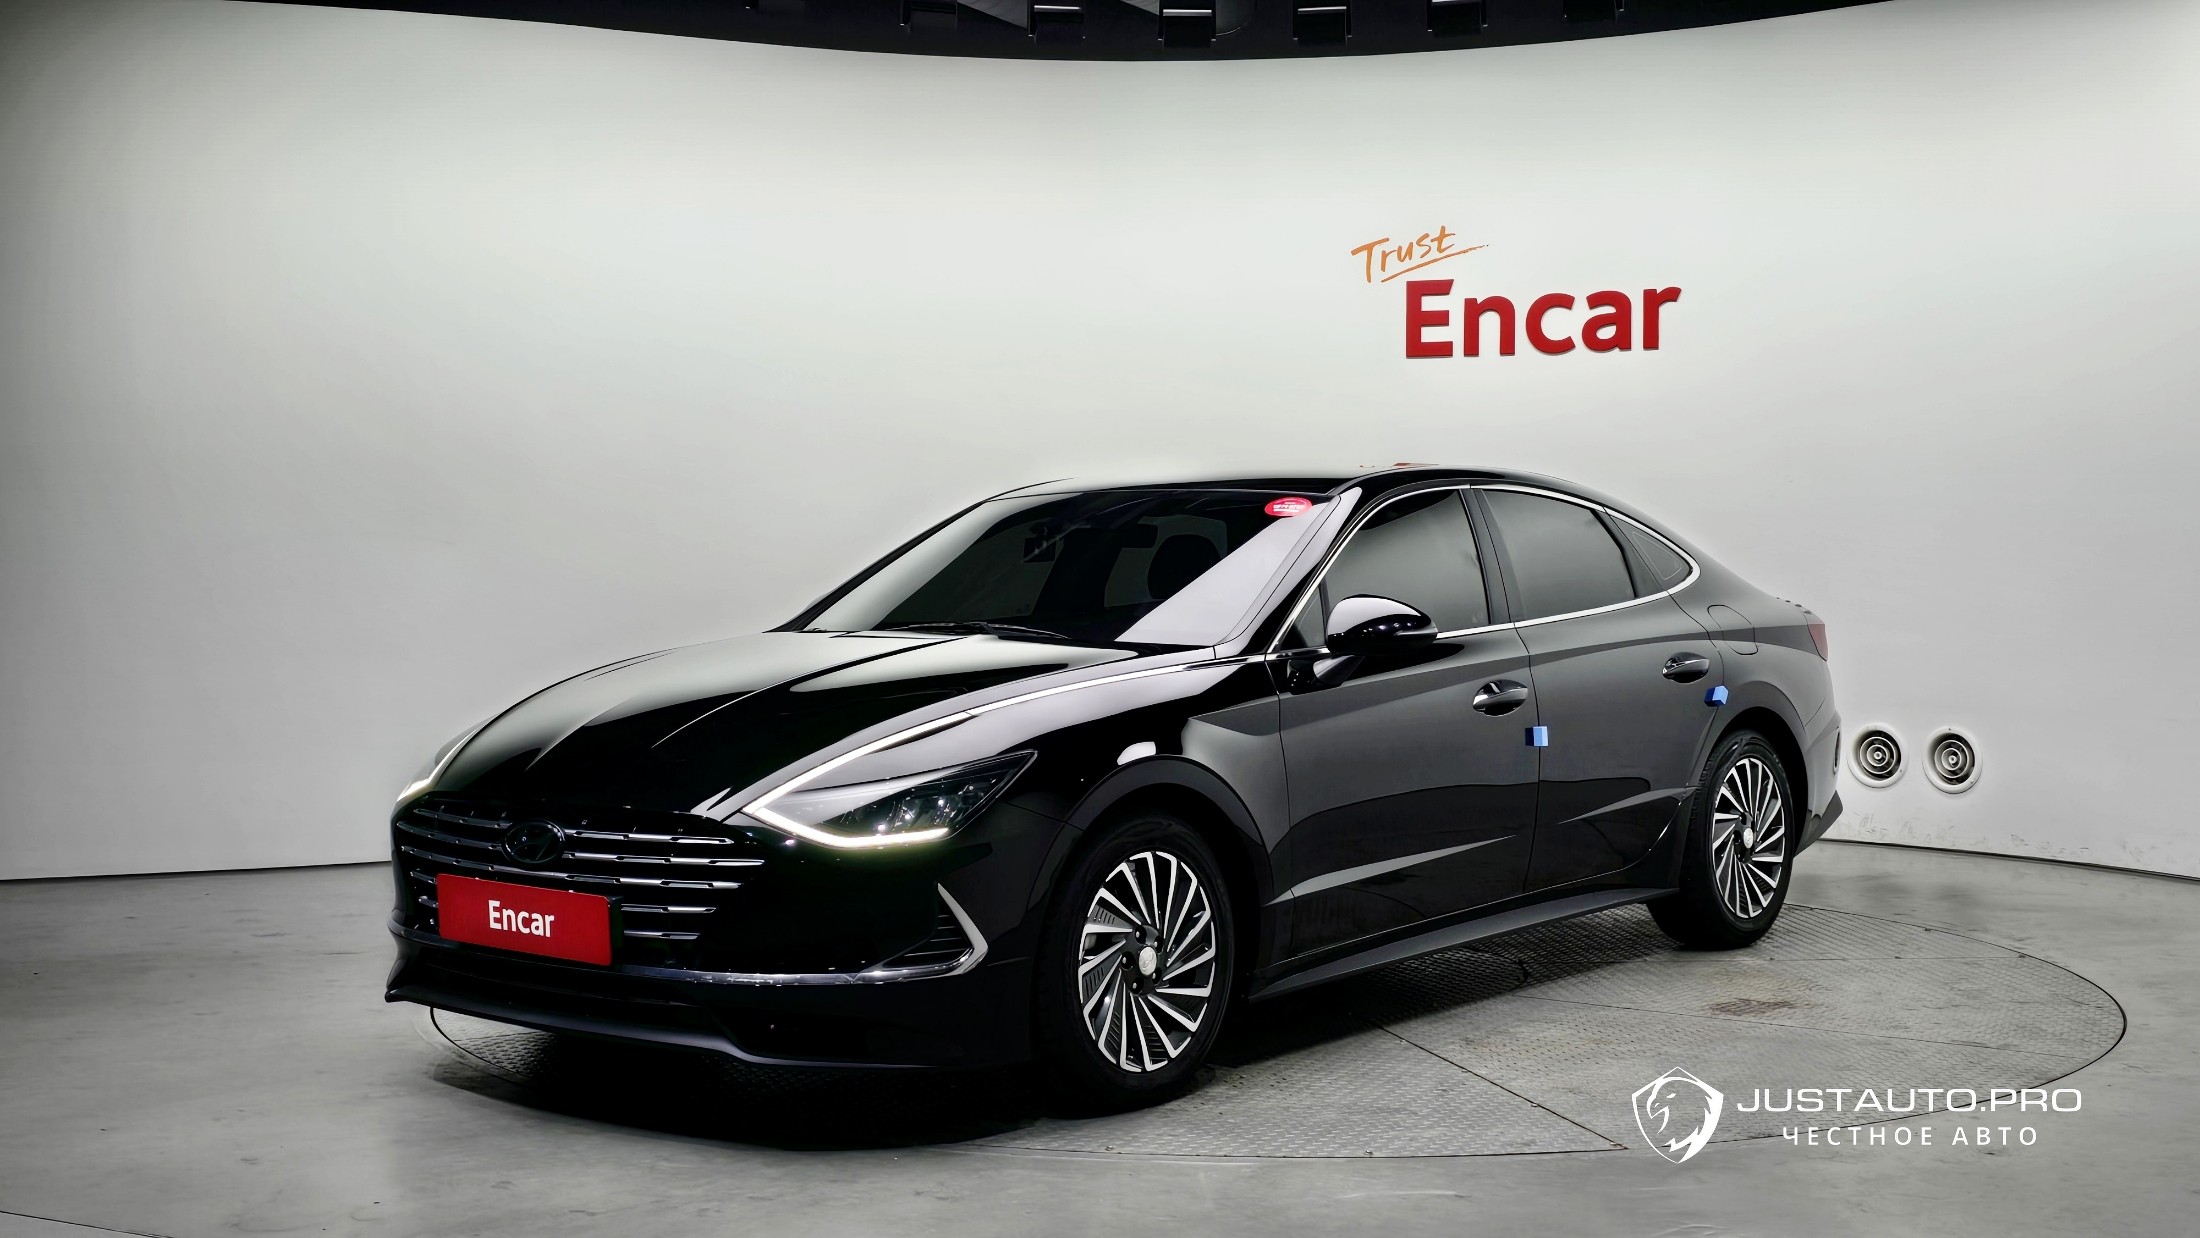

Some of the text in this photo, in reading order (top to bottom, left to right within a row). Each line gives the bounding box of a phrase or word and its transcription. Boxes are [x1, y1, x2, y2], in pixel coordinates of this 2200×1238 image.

[1350, 225, 1456, 283] Trust
[1405, 279, 1682, 359] Encar
[487, 899, 555, 938] Encar
